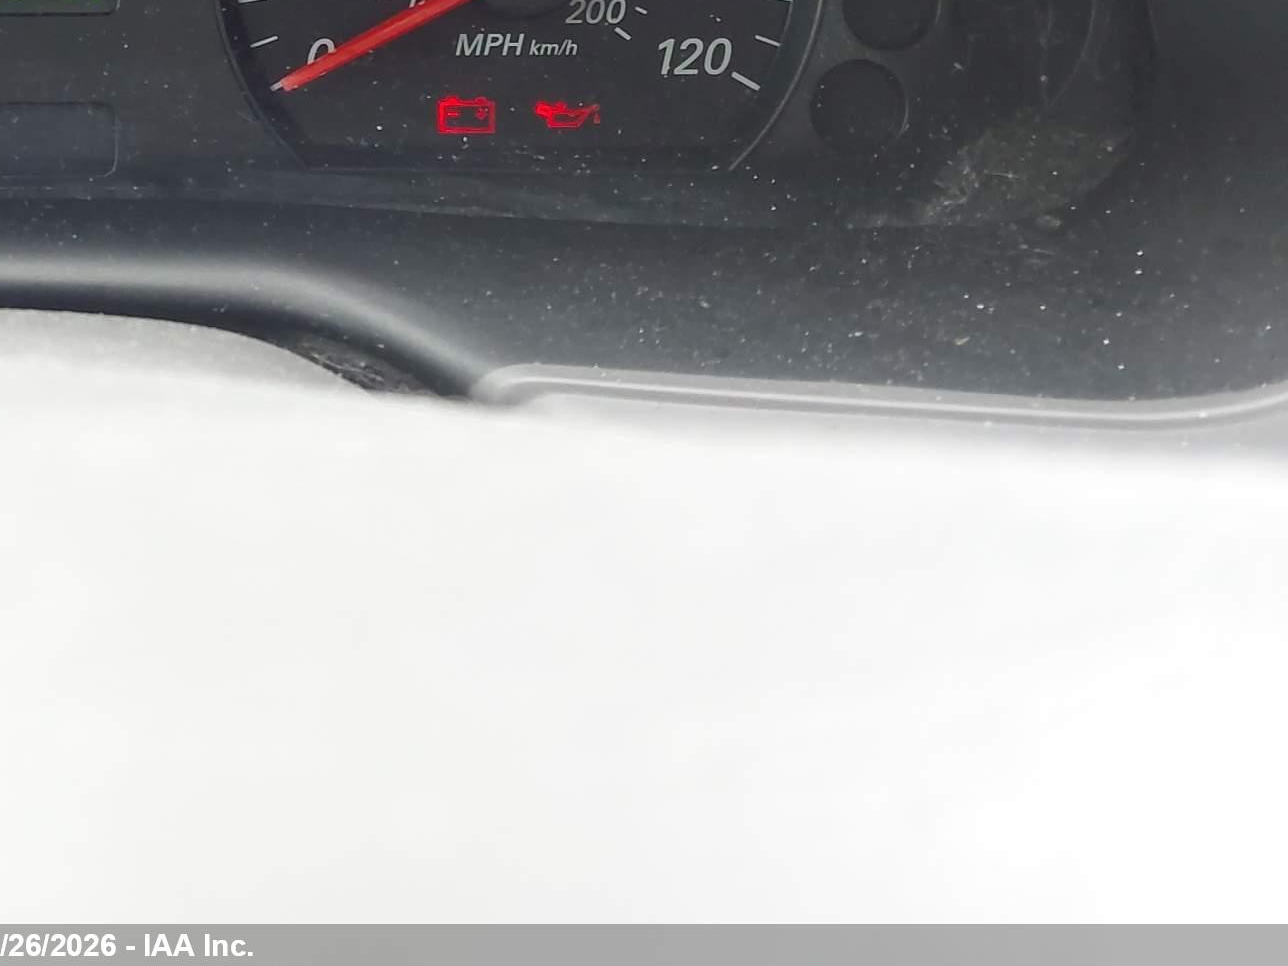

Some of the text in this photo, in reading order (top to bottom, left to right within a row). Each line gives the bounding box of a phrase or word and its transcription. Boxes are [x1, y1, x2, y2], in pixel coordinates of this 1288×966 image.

[455, 33, 579, 56] MPH km/h
[657, 37, 732, 76] 120
